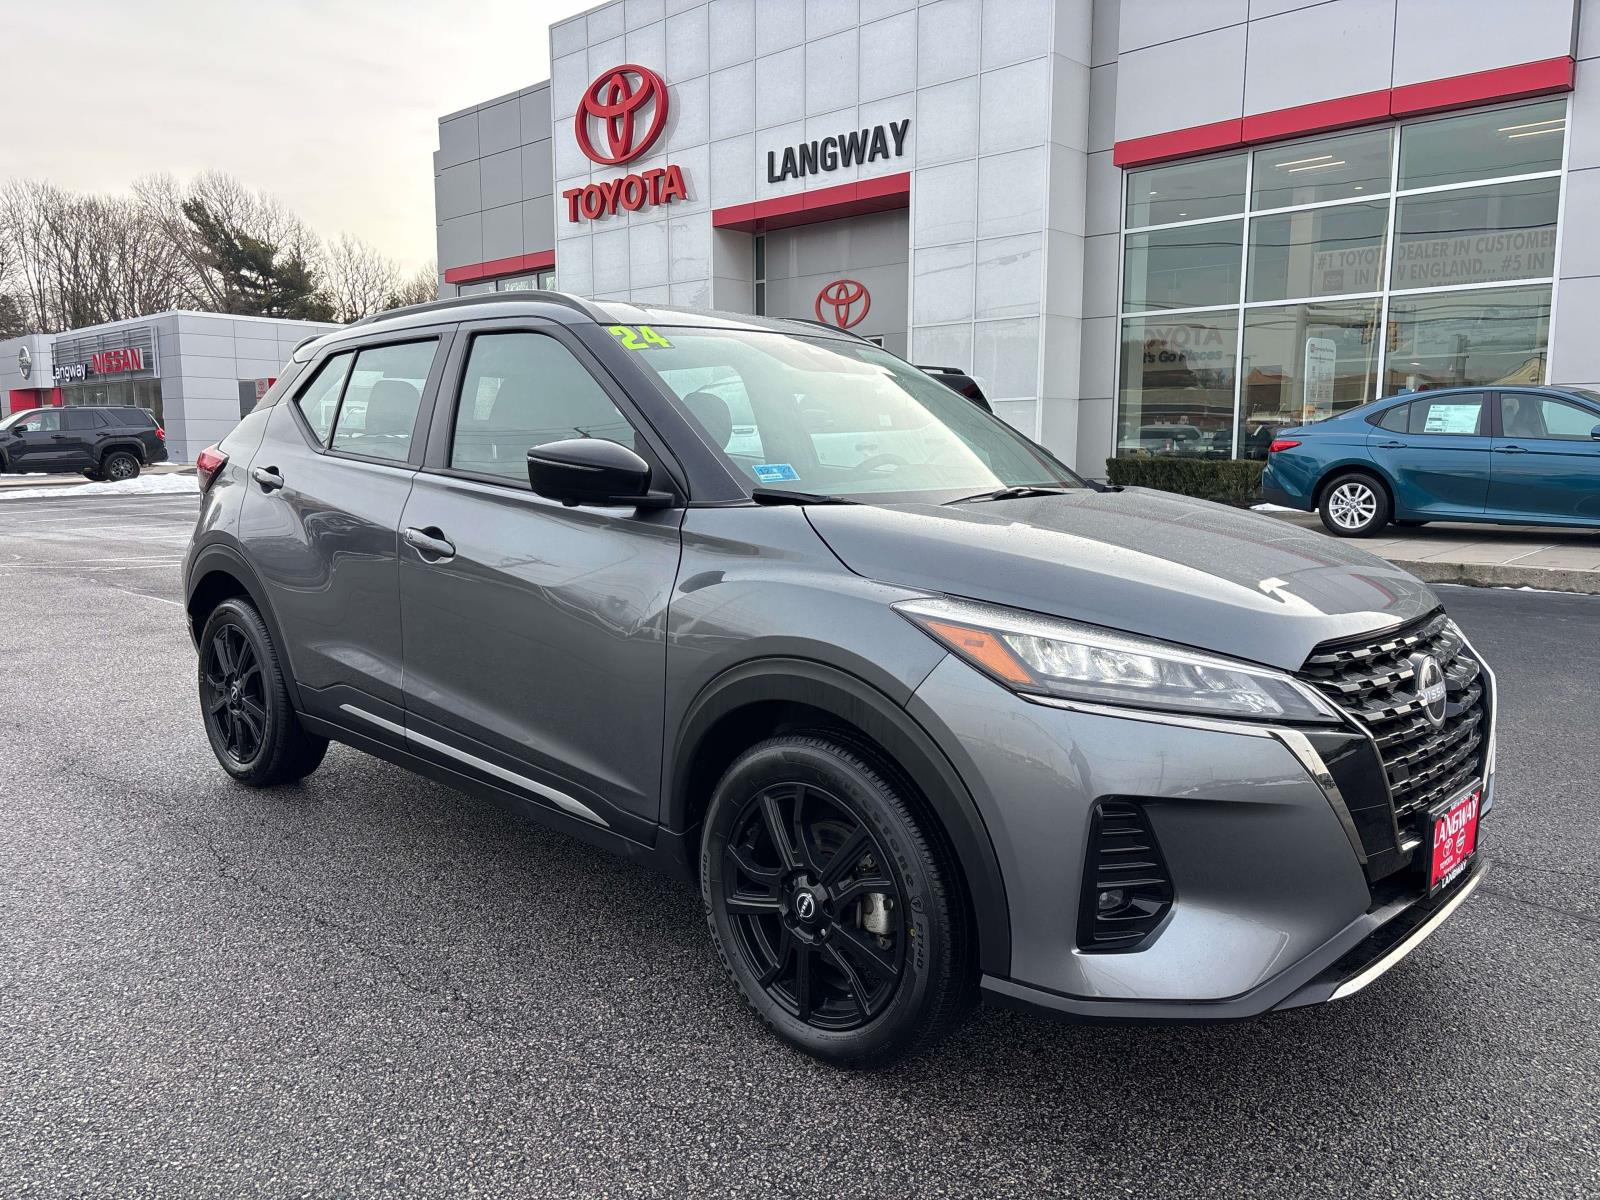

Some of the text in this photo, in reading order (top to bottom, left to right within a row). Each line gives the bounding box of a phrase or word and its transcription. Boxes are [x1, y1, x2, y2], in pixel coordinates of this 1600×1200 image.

[767, 118, 910, 183] LANGWAY
[563, 164, 688, 223] TOYOTA
[1317, 252, 1333, 270] #1
[1340, 247, 1382, 266] TOYO
[1453, 238, 1471, 256] IN
[1502, 254, 1522, 273] #5
[1527, 252, 1545, 270] IN
[607, 325, 671, 351] 24
[51, 348, 144, 383] Langway NISSAN
[1433, 794, 1480, 849] LANGWAY
